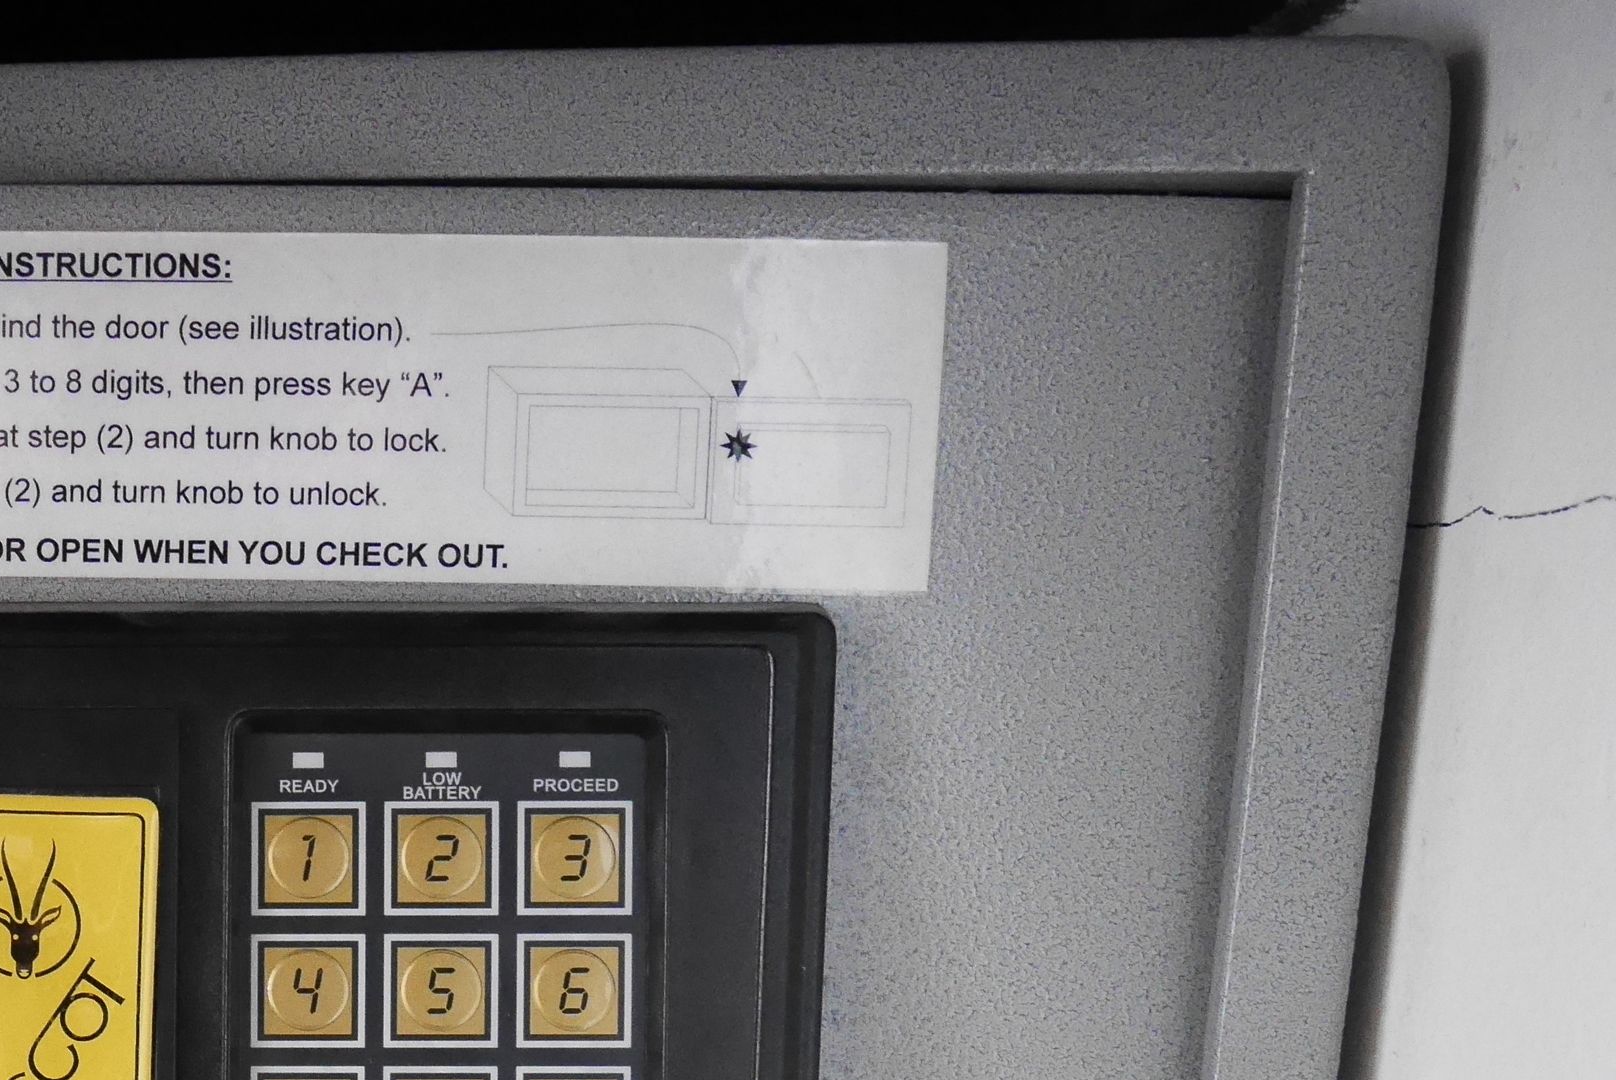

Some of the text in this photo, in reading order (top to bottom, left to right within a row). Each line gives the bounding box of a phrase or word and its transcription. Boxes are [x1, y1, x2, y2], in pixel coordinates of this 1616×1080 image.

[51, 313, 96, 340] the
[104, 313, 170, 340] door
[178, 314, 240, 346] (see
[249, 314, 411, 348] illustration).
[4, 368, 20, 394] 3
[29, 369, 56, 394] to
[65, 368, 82, 394] 8
[91, 368, 172, 401] digits,
[182, 369, 244, 396] then
[254, 376, 332, 402] press
[342, 370, 391, 404] key
[27, 424, 87, 455] step
[96, 423, 134, 456] (2)
[143, 424, 196, 450] and
[205, 425, 260, 451] turn
[269, 425, 338, 451] knob
[346, 427, 374, 452] to
[384, 426, 447, 453] lock.
[4, 477, 41, 509] (2)
[51, 477, 103, 504] and
[111, 479, 166, 504] turn
[176, 479, 244, 505] knob
[252, 481, 280, 506] to
[289, 480, 387, 507] unlock.
[36, 537, 124, 564] OPEN
[133, 538, 229, 565] WHEN
[237, 539, 306, 566] YOU
[315, 540, 428, 568] CHECK
[437, 542, 508, 569] OUT.
[279, 779, 339, 794] READY
[402, 785, 482, 800] BATTERY
[422, 772, 462, 787] LOW
[532, 778, 620, 793] PROCEED
[302, 834, 591, 882] 1 2 3
[293, 967, 590, 1015] 4 5 6
